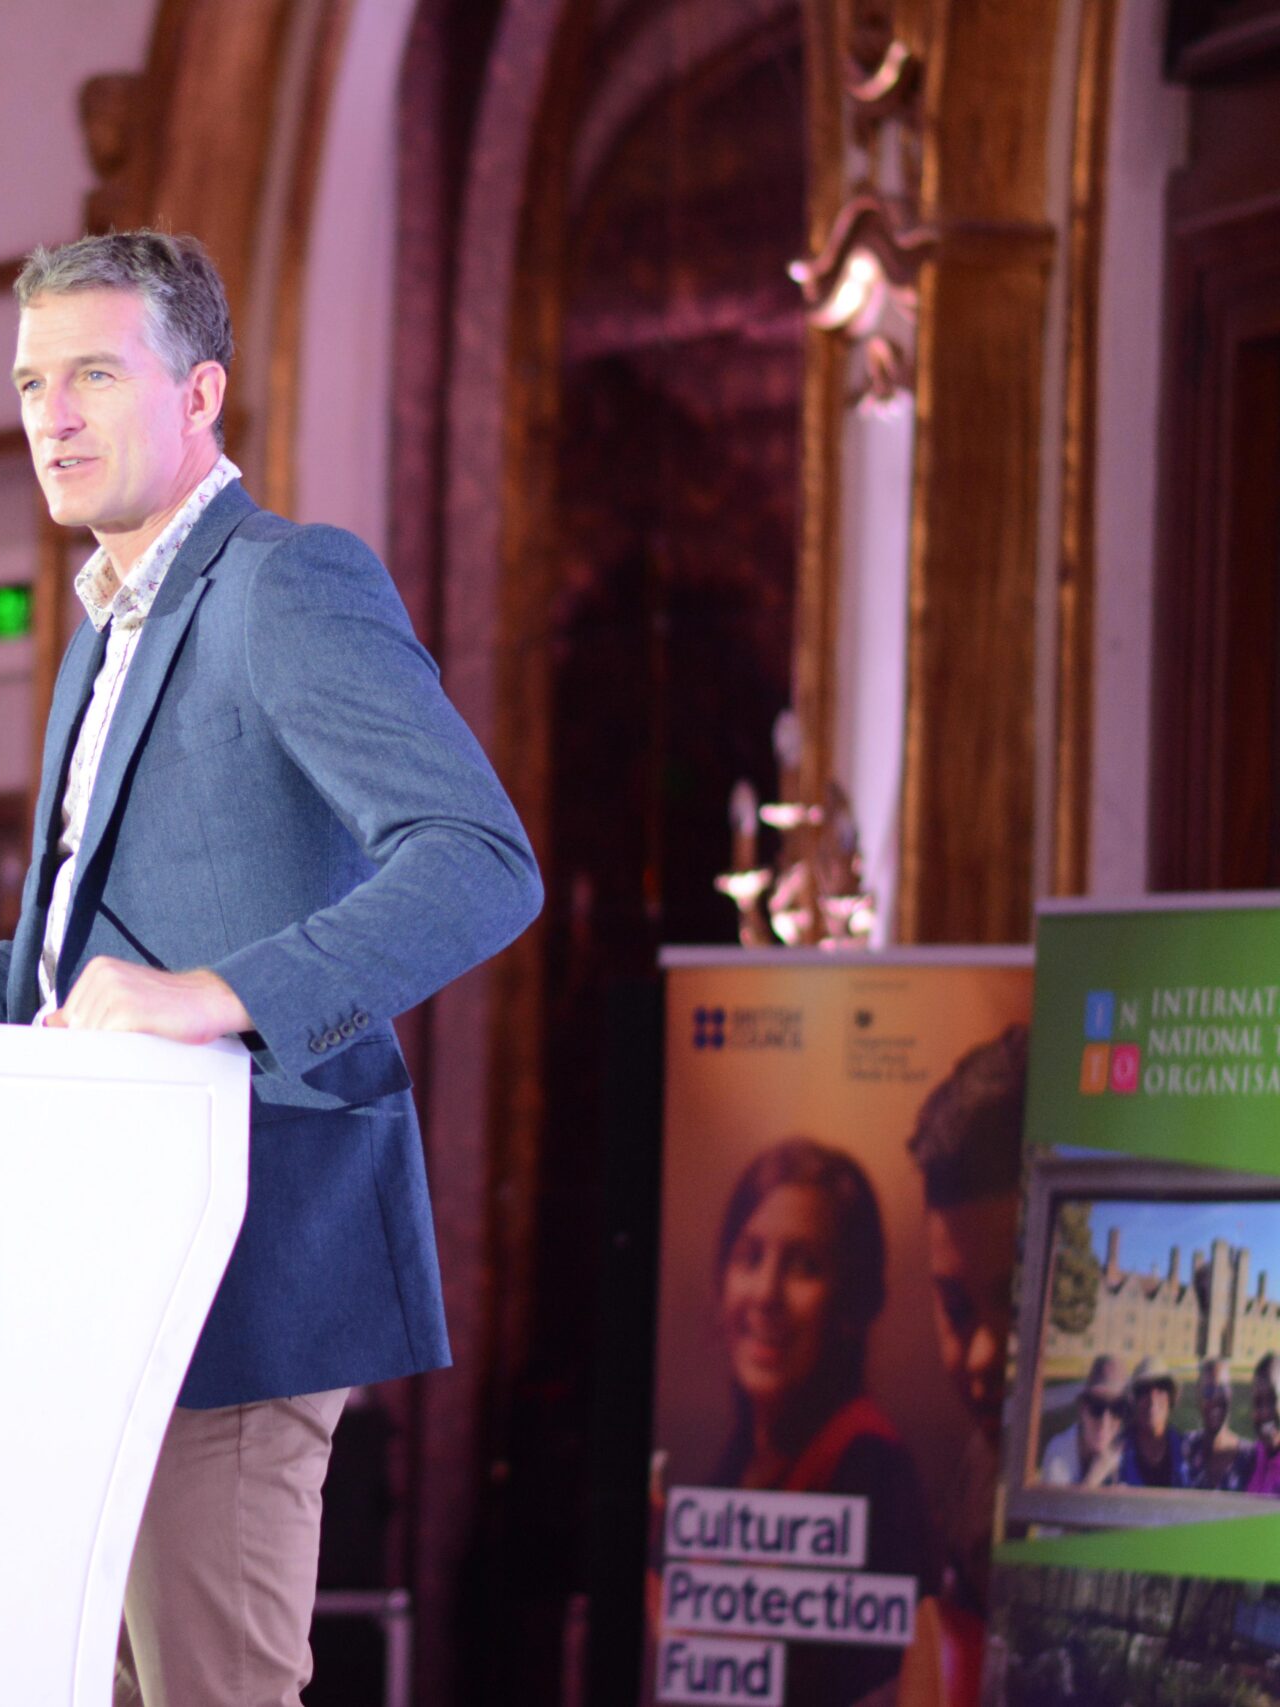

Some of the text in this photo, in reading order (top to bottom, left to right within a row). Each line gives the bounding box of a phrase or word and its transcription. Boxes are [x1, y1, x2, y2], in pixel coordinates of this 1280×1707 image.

[1151, 986, 1280, 1019] INTERNAT
[1147, 1026, 1262, 1057] NATIONAL
[674, 1498, 851, 1555] Cultural
[668, 1571, 908, 1633] Protection
[665, 1642, 773, 1698] Fund
